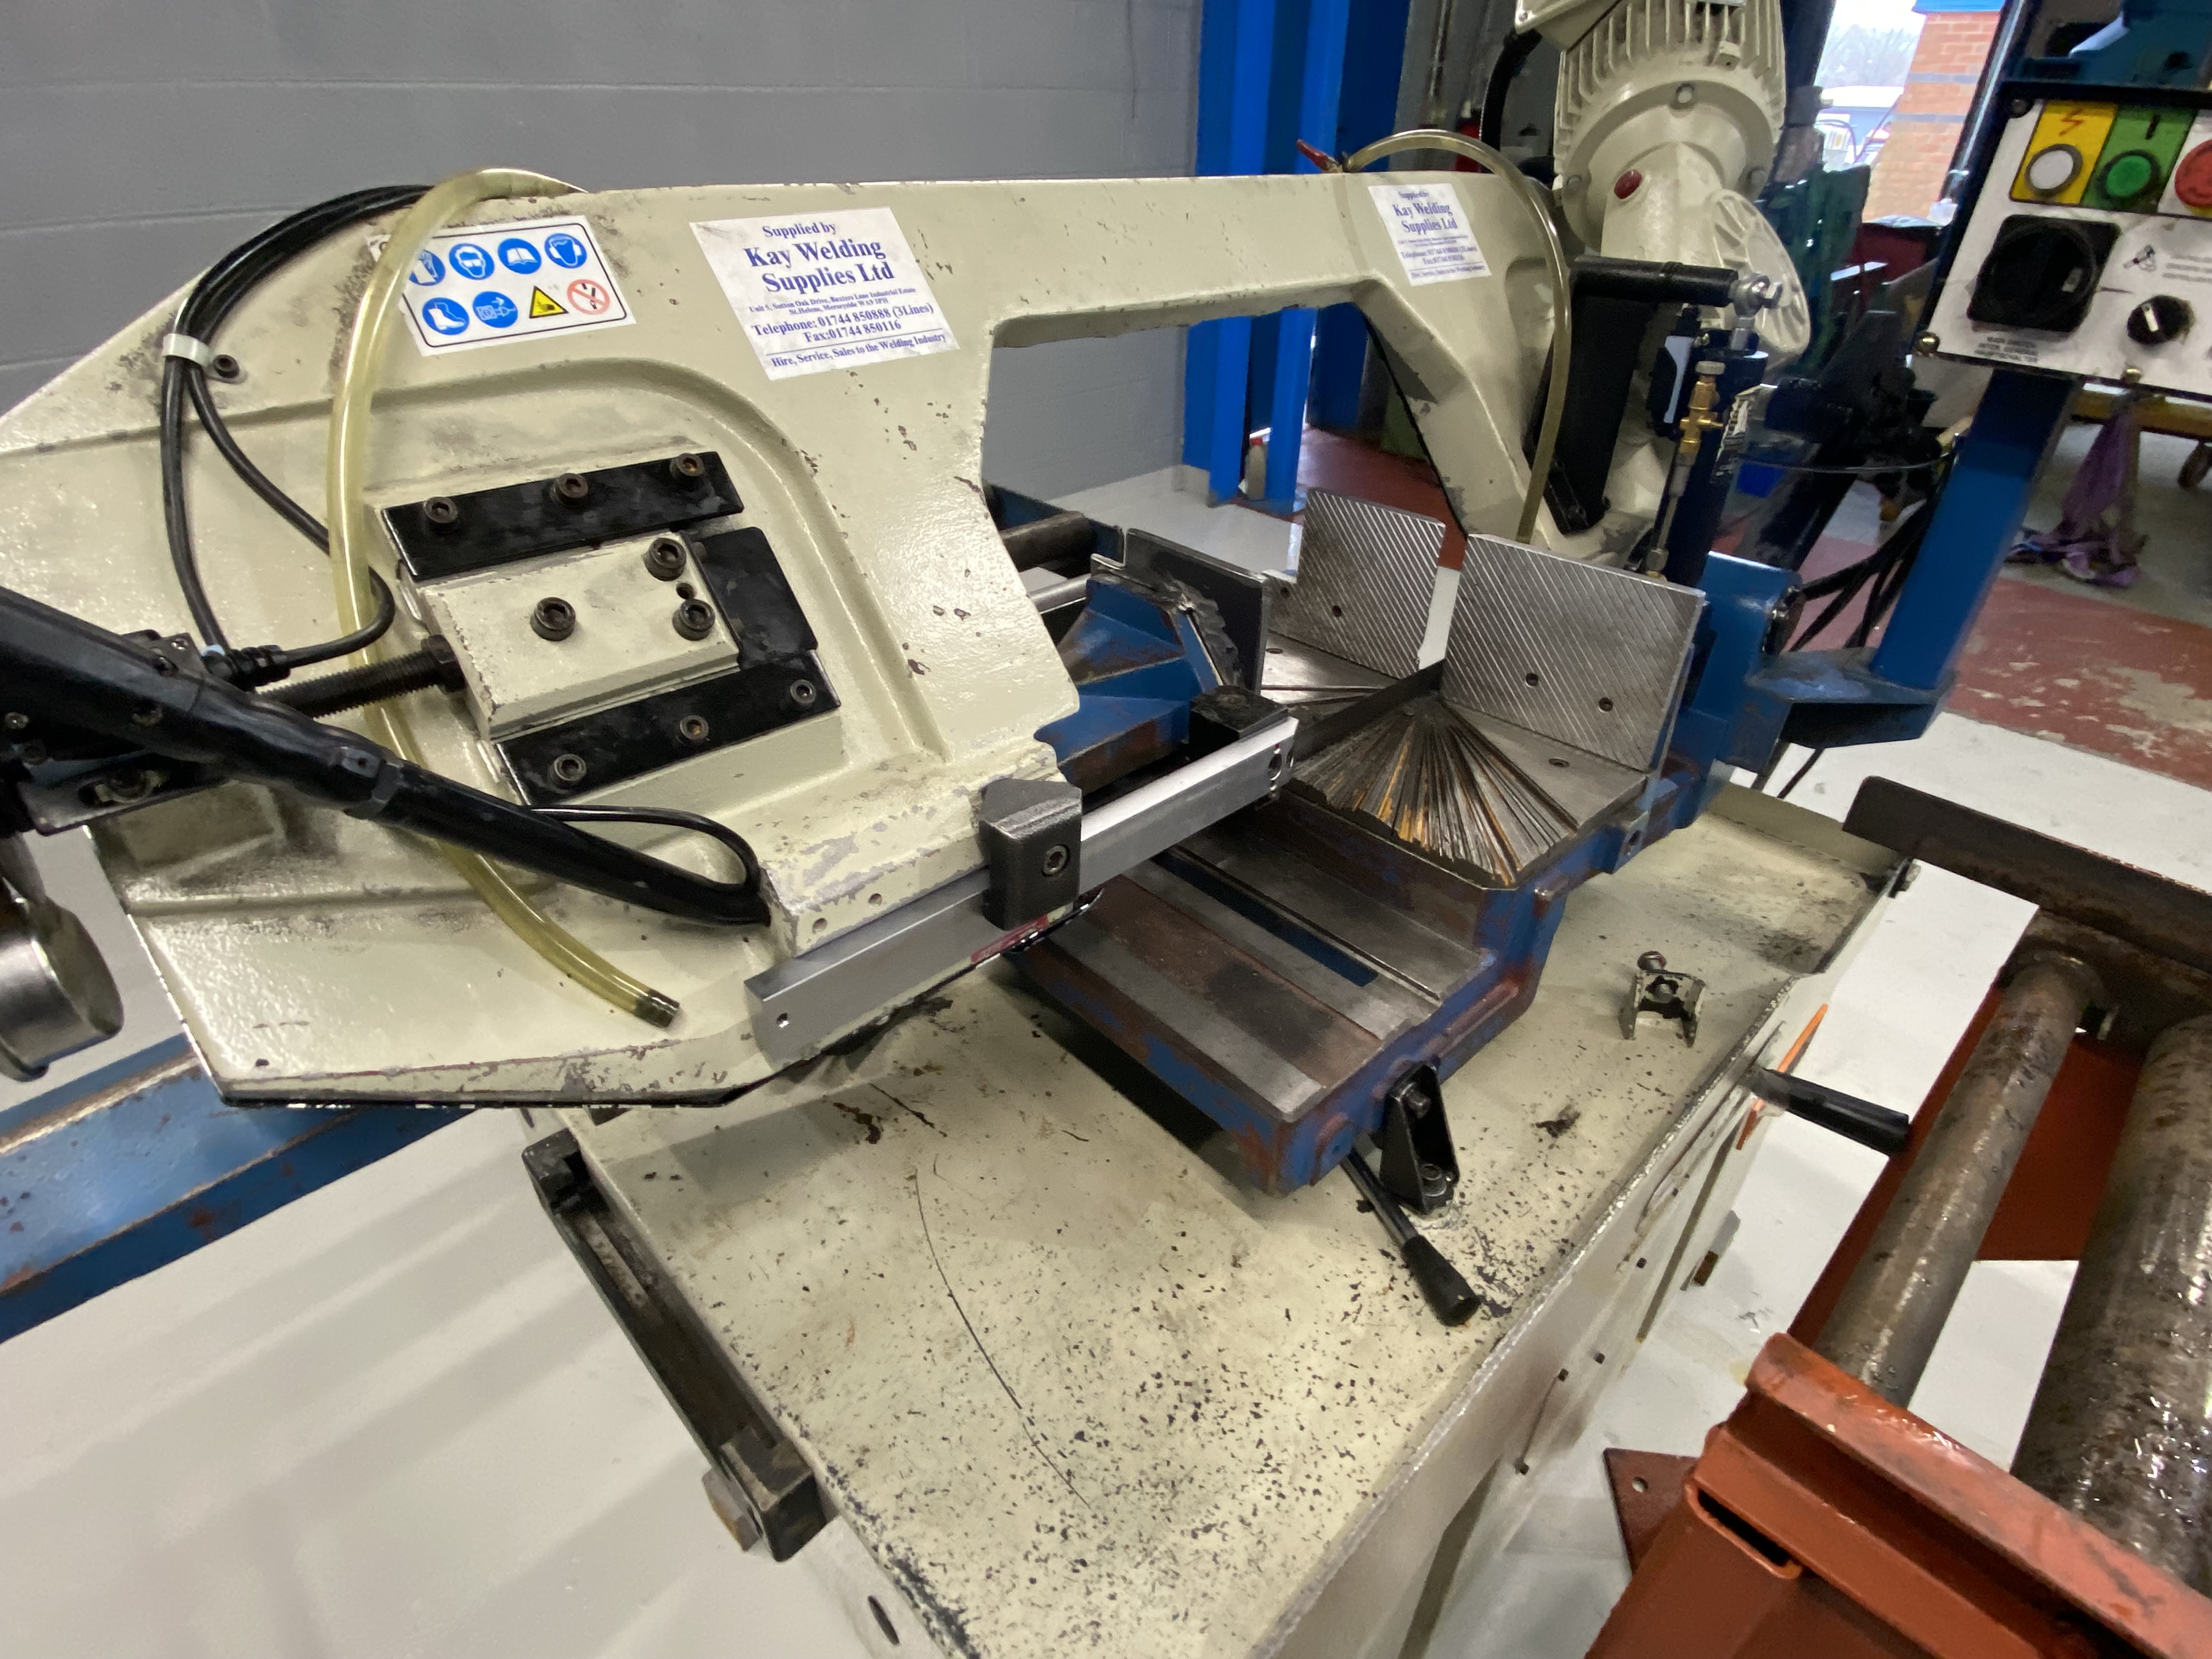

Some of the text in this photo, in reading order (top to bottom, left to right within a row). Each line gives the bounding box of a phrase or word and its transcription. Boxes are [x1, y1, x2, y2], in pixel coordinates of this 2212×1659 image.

[1392, 202, 1453, 219] Kay Welding
[762, 222, 836, 239] Supplied by
[1401, 218, 1458, 235] Supplies Ltd
[743, 239, 886, 268] Kay Welding
[762, 261, 895, 294] Supplies Ltd
[751, 302, 934, 336] Telephone: 01744 850888 (3Lines)
[803, 319, 901, 342] Fax:01744 850116
[771, 357, 798, 367] Hire,
[796, 351, 834, 363] Service,
[832, 348, 855, 357] Sales
[866, 344, 879, 352] the
[879, 338, 915, 349] Welding
[913, 334, 946, 345] Industry
